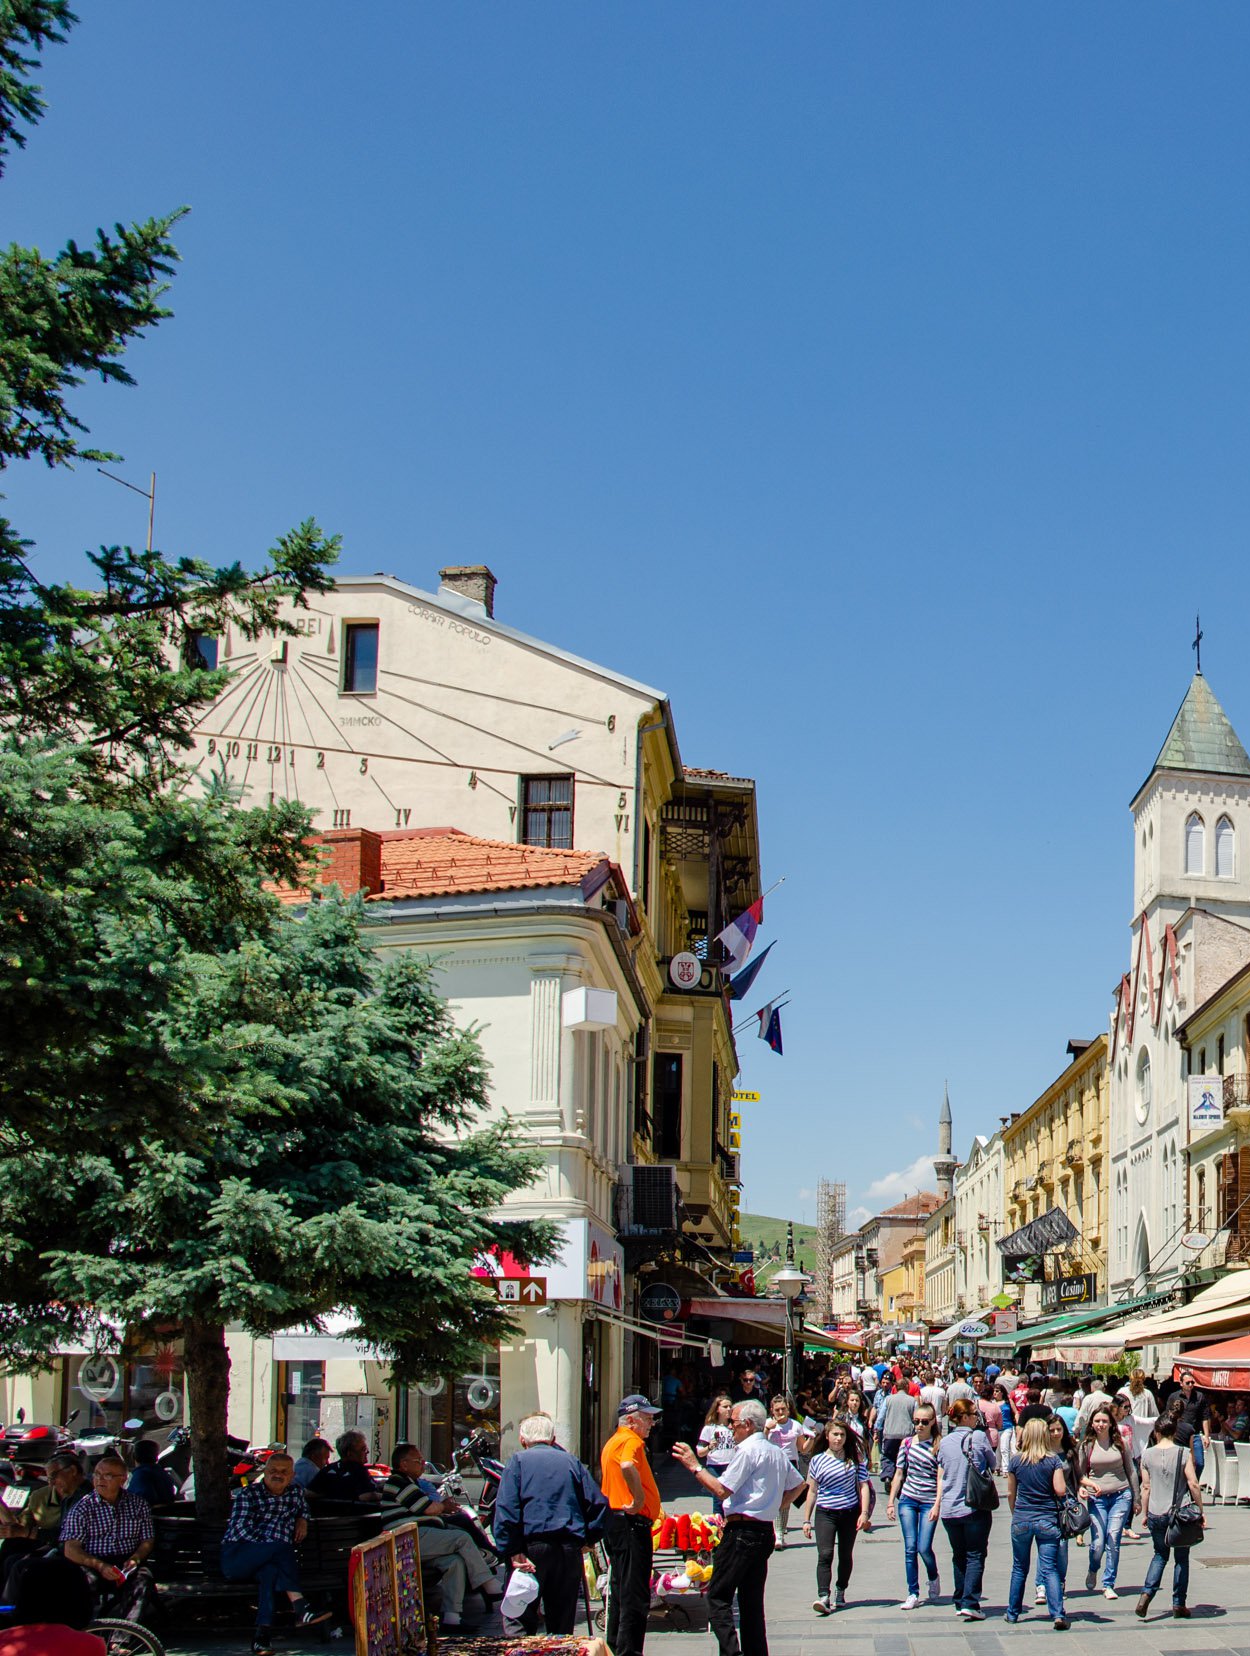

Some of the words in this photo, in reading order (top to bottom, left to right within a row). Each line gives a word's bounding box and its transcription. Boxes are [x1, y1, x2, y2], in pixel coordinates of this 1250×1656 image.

[447, 620, 492, 646] POPULO
[607, 714, 616, 733] 6
[207, 738, 216, 755] 9
[225, 741, 240, 758] 10
[246, 743, 259, 760] 11
[267, 746, 282, 763] 12
[289, 750, 295, 766] 1
[317, 752, 325, 769] 2
[468, 770, 478, 790] 4
[618, 792, 627, 810] 5
[332, 809, 352, 828] III
[395, 808, 412, 828] IV
[508, 806, 517, 825] V
[614, 814, 630, 833] VI
[1061, 1281, 1084, 1298] Casino
[1210, 1370, 1231, 1388] AMSTEL
